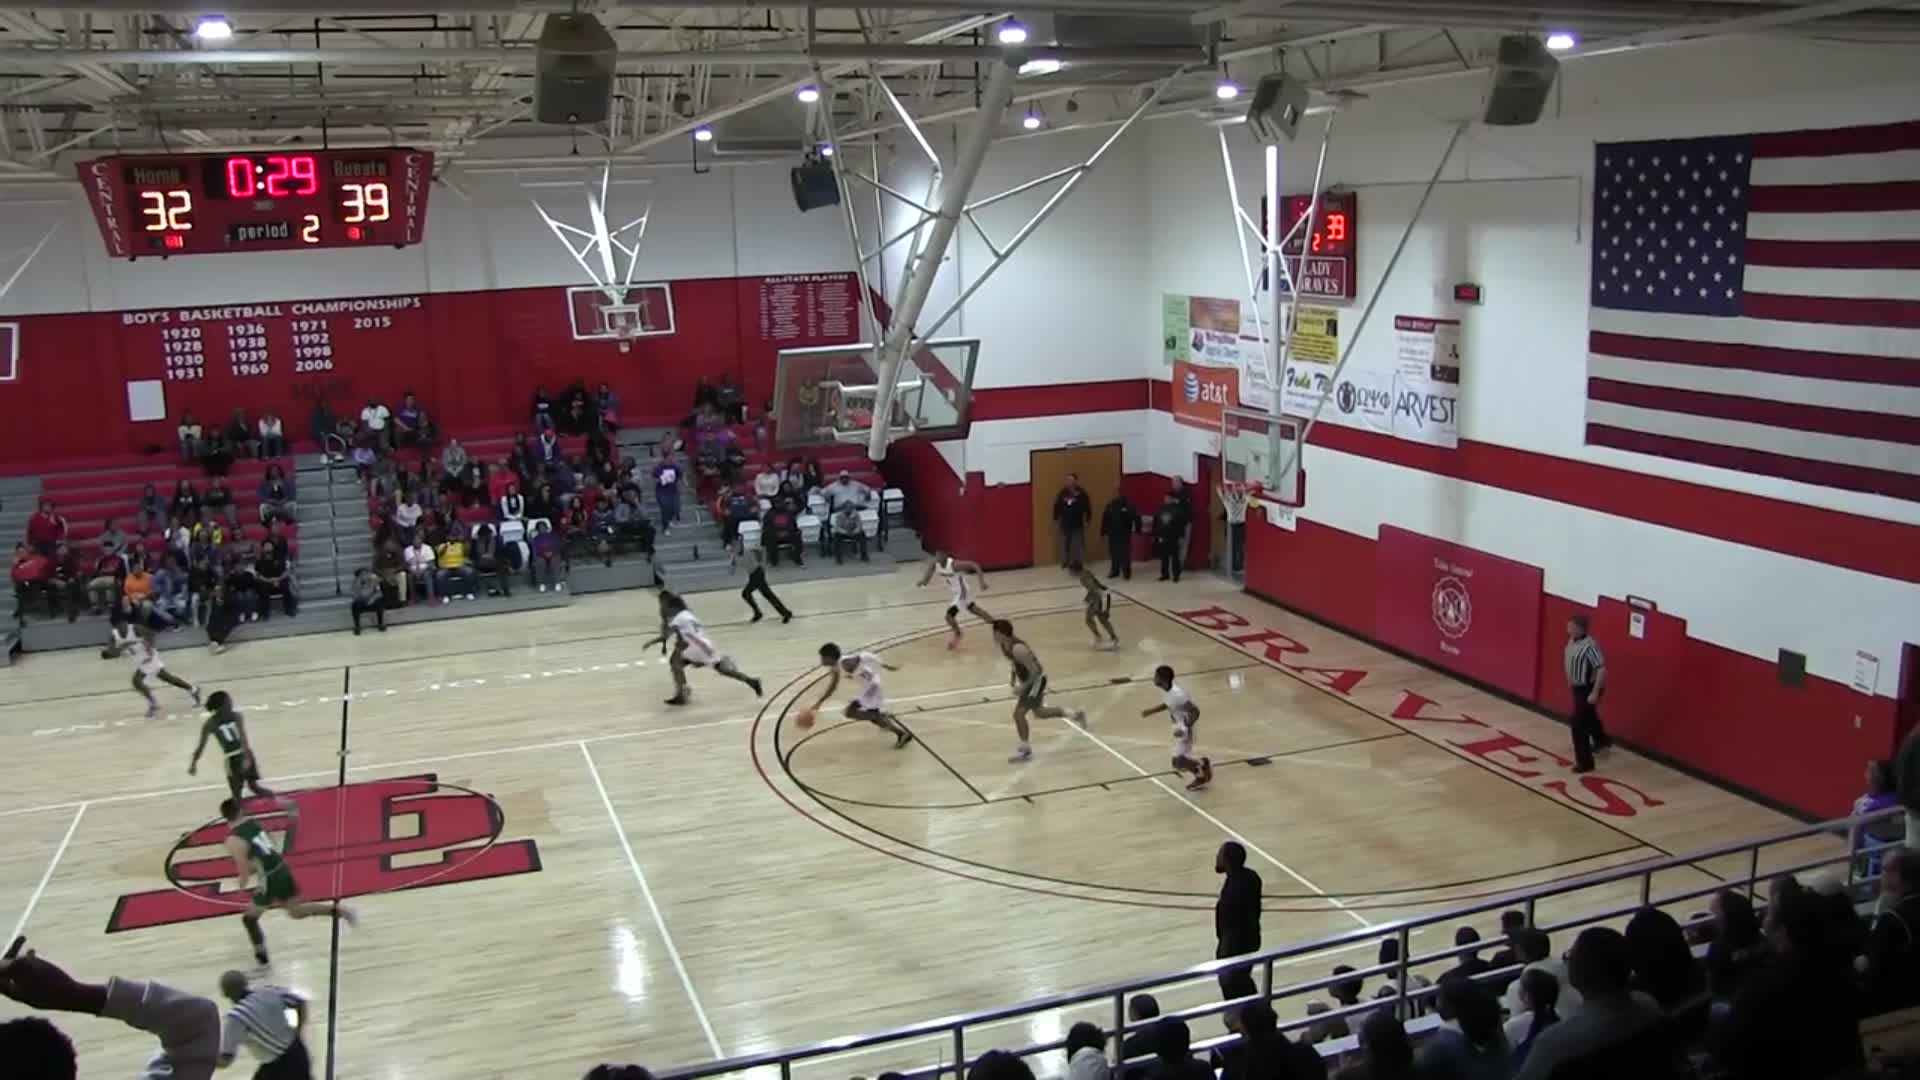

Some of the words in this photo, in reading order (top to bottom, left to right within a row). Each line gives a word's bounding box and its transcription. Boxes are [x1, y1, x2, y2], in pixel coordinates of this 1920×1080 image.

[228, 156, 317, 197] 0:29
[141, 190, 192, 231] 32
[341, 183, 390, 222] 39
[238, 221, 288, 240] period
[303, 214, 320, 243] 2
[122, 311, 170, 325] BOY'S
[179, 305, 284, 322] BASKETBALL
[291, 297, 422, 315] CHAMPIONSHIPS
[162, 328, 201, 340] 1920
[227, 324, 266, 336] 1936
[291, 319, 328, 332] 1971
[353, 316, 392, 329] 2015
[164, 341, 203, 353] 1928
[228, 337, 267, 349] 1938
[293, 333, 330, 345] 1992
[165, 354, 204, 366] 1930
[230, 350, 269, 363] 1939
[295, 346, 332, 358] 1998
[167, 367, 204, 380] 1931
[232, 363, 270, 376] 1969
[295, 359, 334, 372] 2006
[1200, 381, 1229, 406] at&t
[1394, 389, 1457, 428] ARVEST
[1175, 605, 1664, 817] BRAVES
